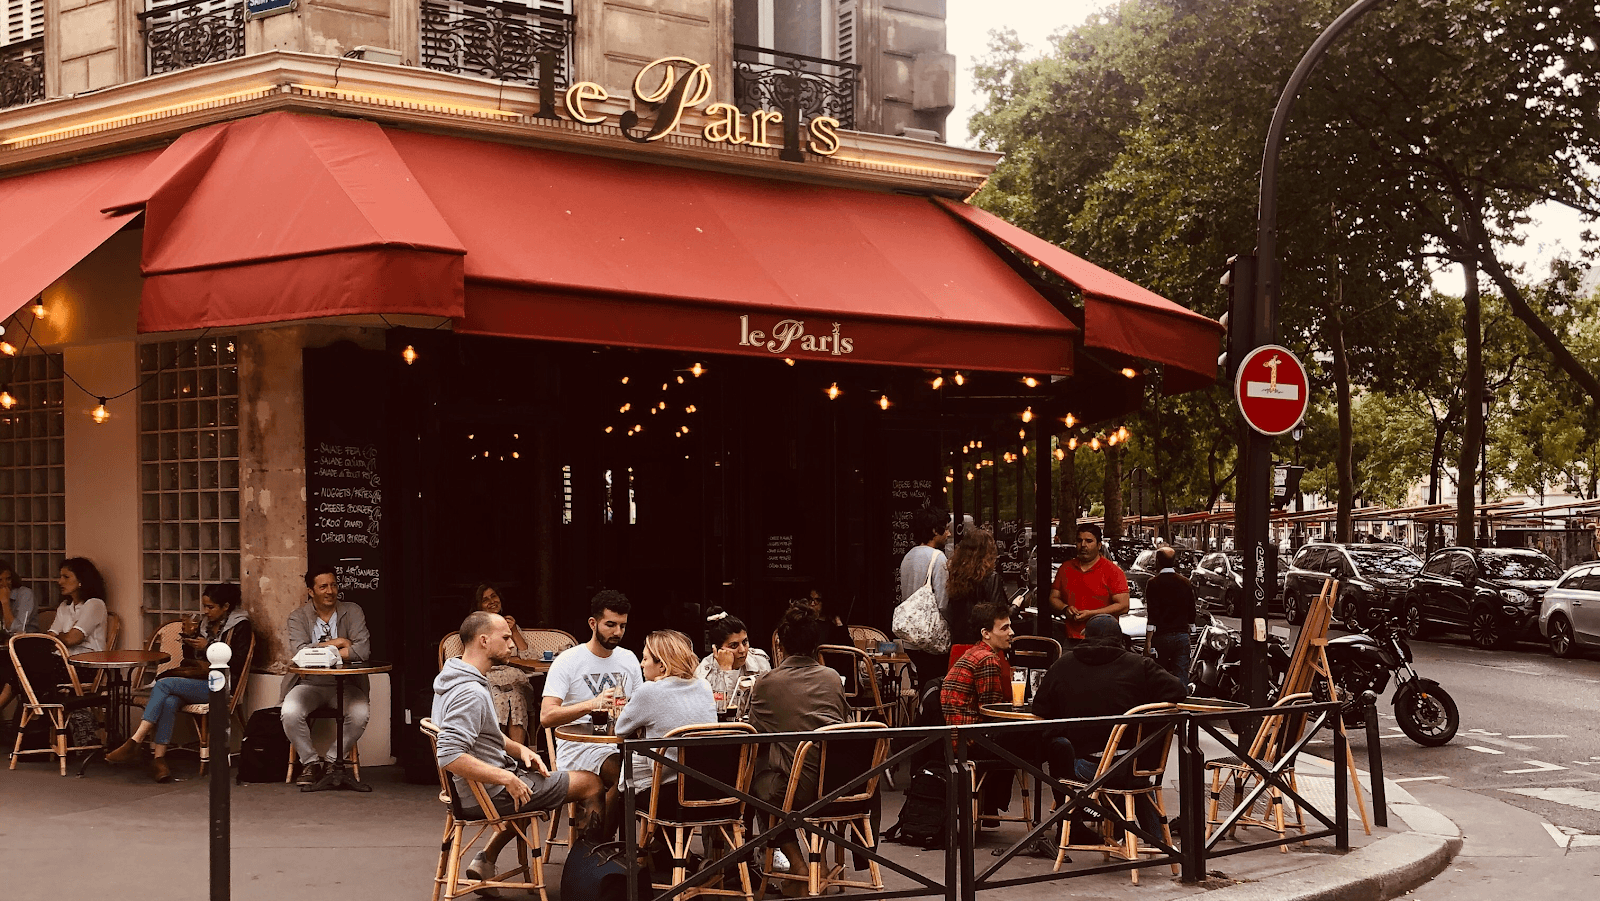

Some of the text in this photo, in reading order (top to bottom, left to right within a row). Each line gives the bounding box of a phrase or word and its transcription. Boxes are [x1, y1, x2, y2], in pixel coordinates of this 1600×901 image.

[532, 50, 841, 162] le Paris
[739, 314, 854, 355] le Paris
